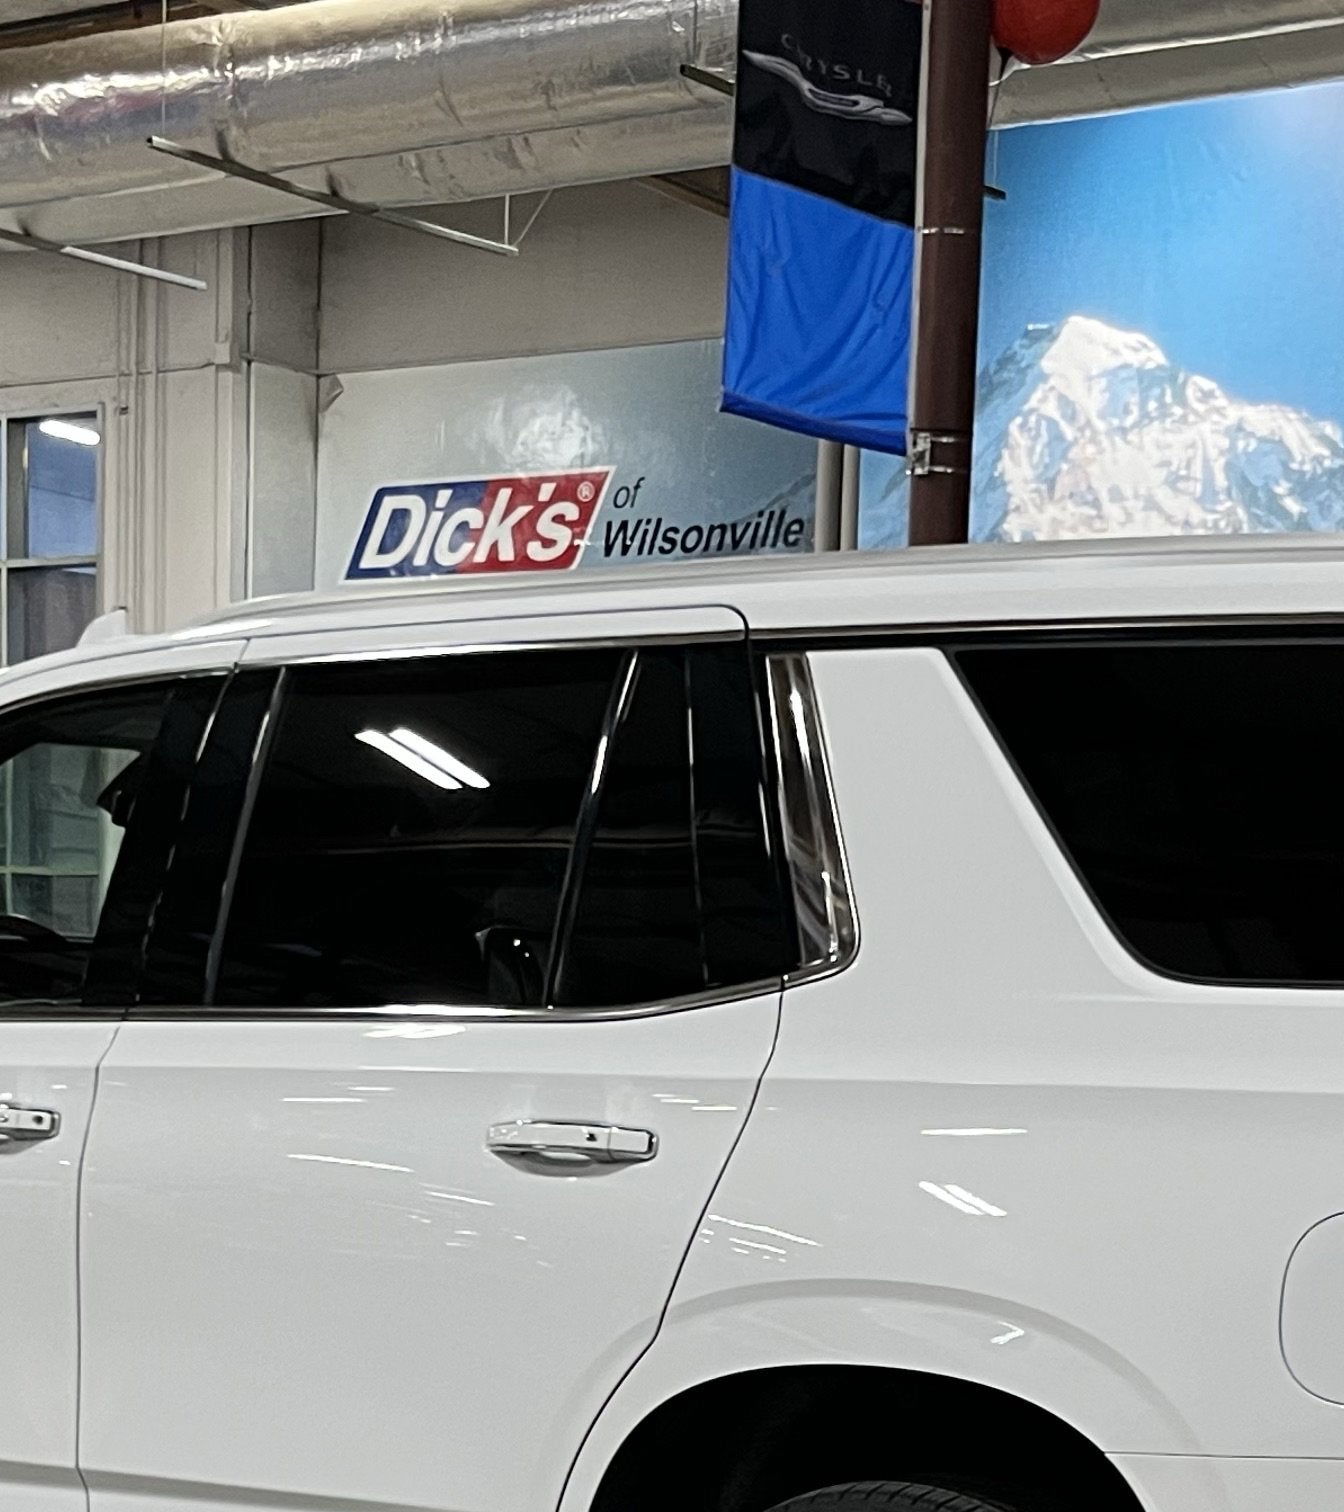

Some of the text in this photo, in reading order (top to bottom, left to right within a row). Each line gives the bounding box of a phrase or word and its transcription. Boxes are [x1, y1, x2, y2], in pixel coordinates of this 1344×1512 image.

[781, 33, 893, 98] CRYSLER
[613, 476, 646, 509] of
[358, 482, 580, 570] Dick's
[604, 509, 805, 557] Wilsonville
